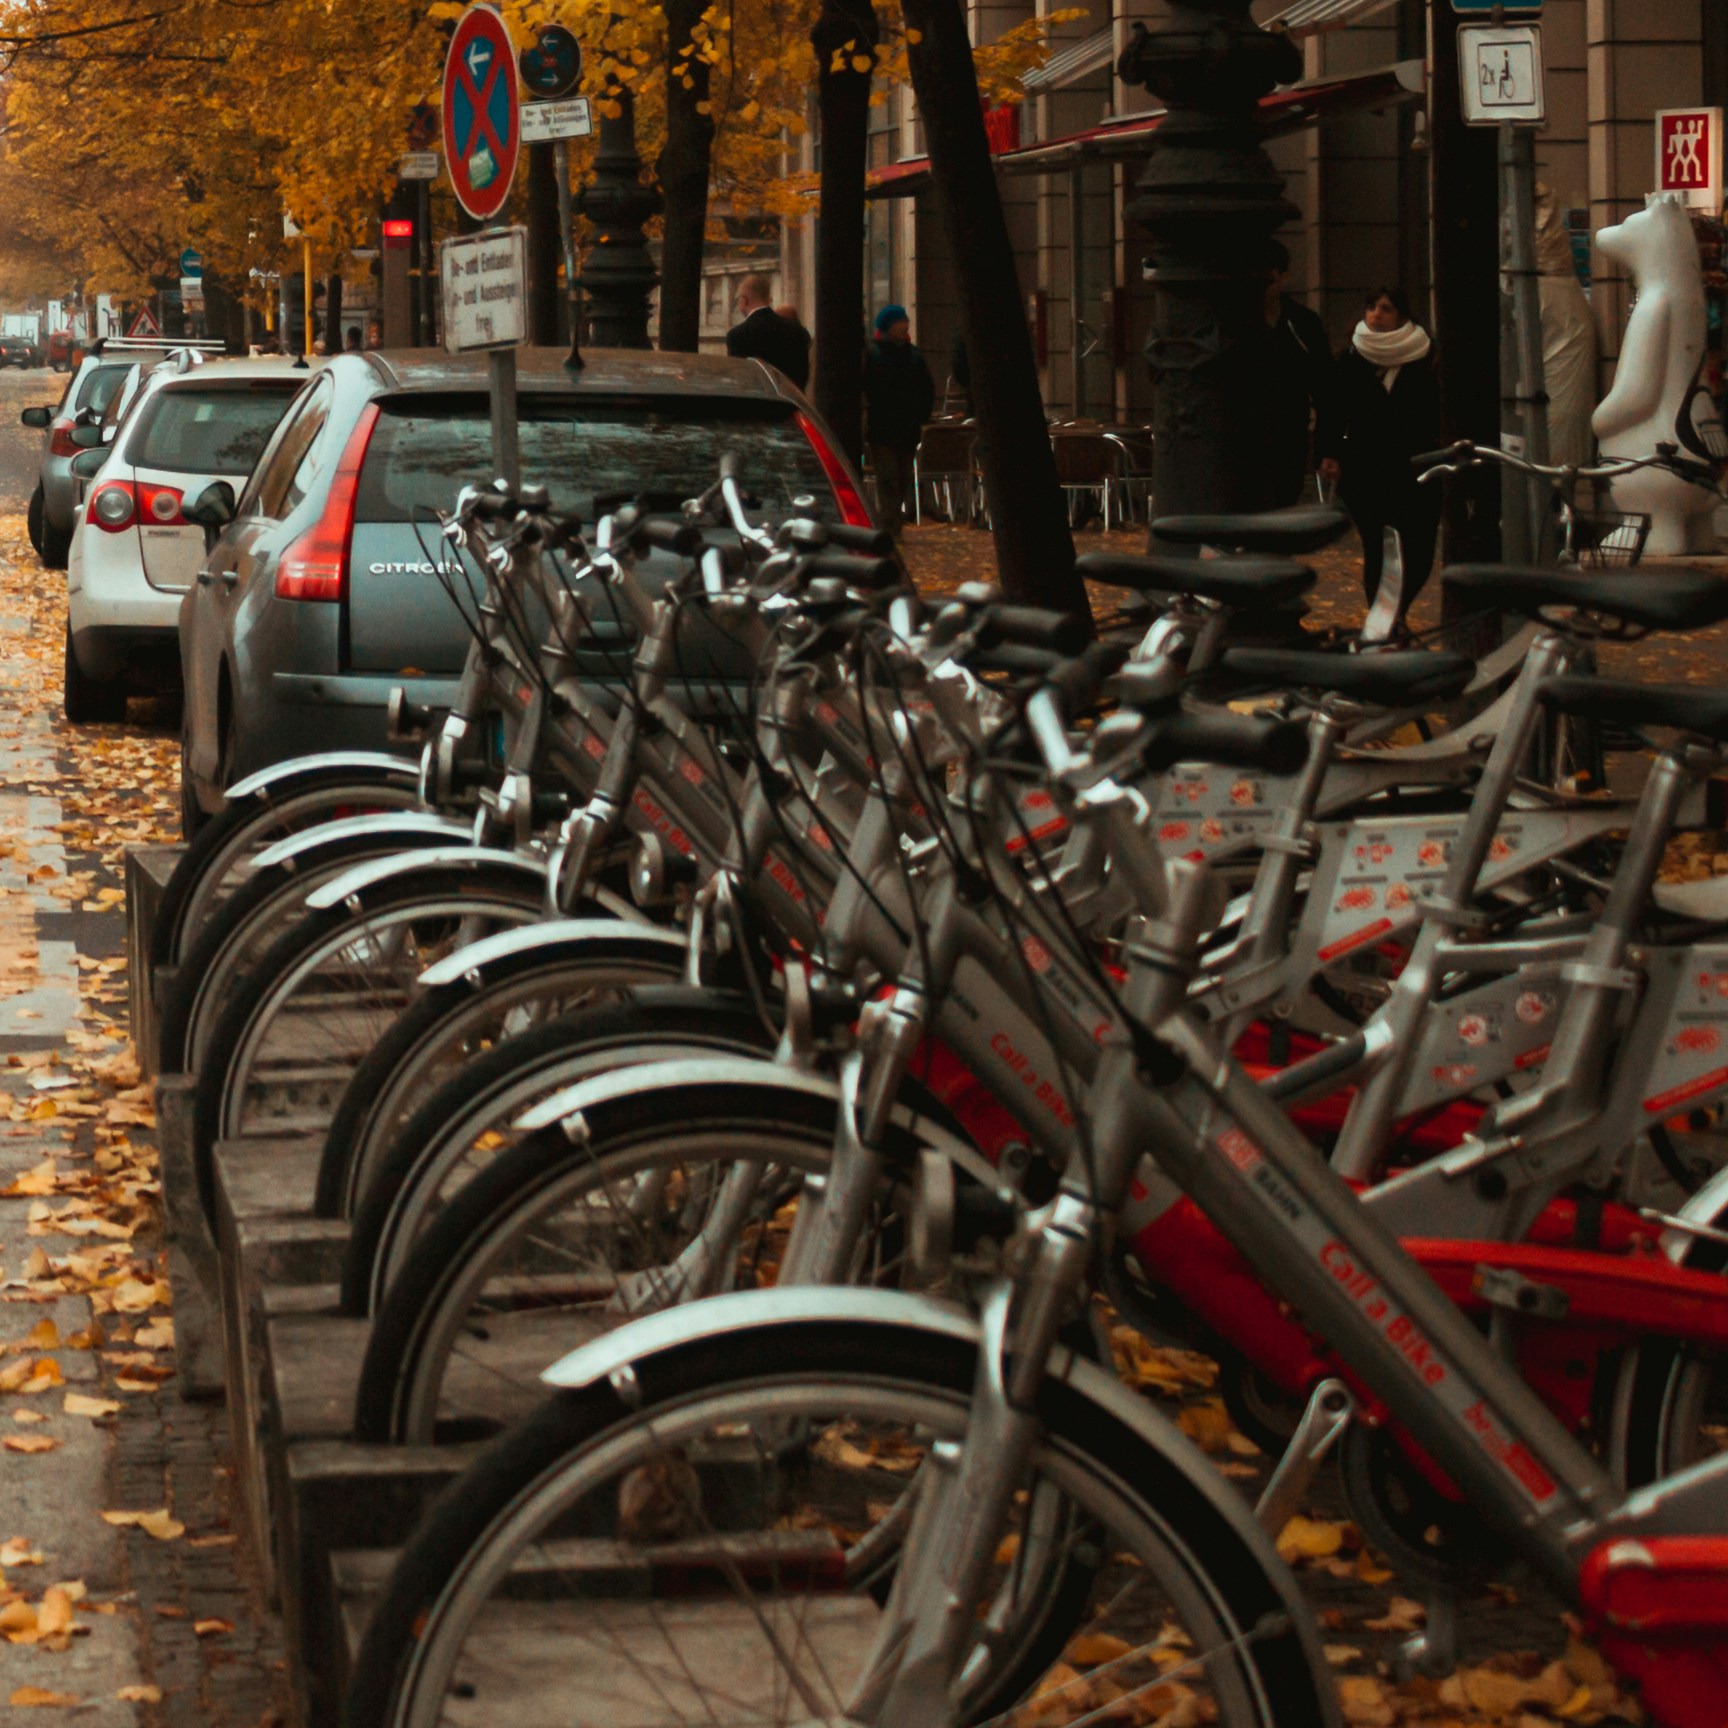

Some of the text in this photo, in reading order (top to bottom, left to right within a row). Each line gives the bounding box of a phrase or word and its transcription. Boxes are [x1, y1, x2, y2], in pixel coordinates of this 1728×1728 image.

[1481, 63, 1495, 86] 2x
[991, 1033, 1075, 1129] Call a Bike
[1319, 1241, 1444, 1386] Call a Bike
